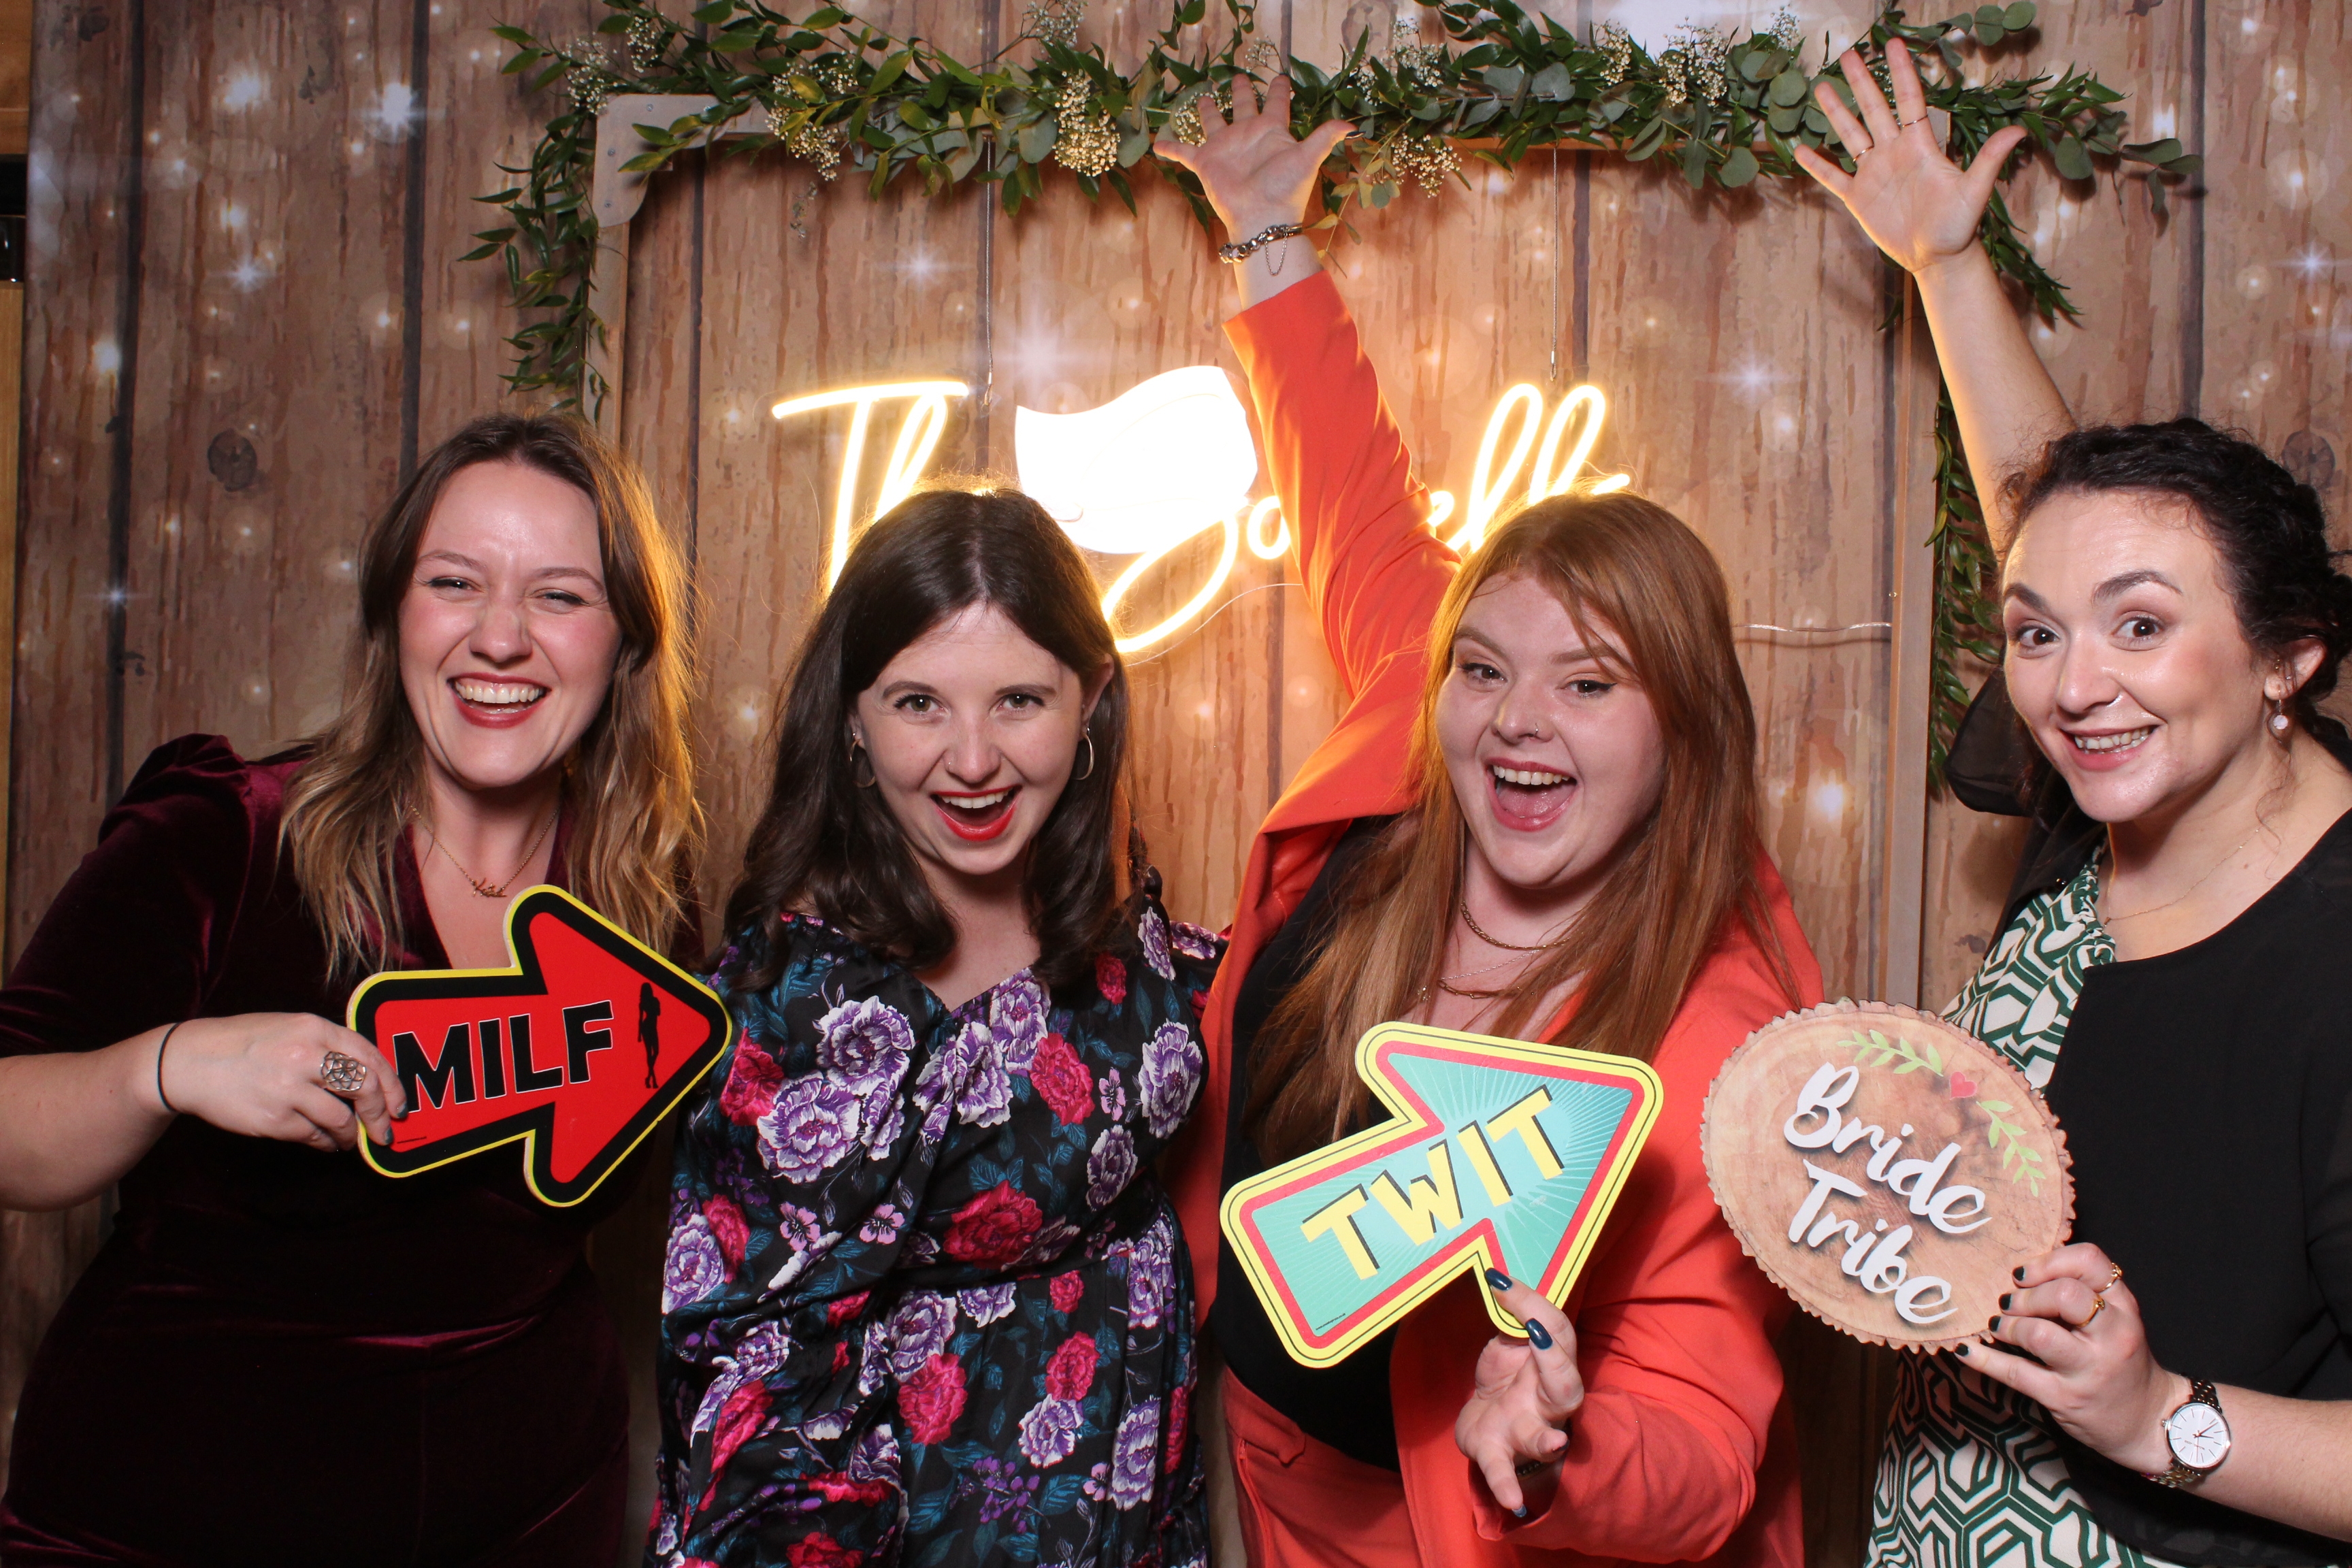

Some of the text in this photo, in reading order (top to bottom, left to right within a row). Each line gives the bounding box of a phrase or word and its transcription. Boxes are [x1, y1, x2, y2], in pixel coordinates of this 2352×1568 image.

[772, 380, 969, 593] Th
[392, 999, 615, 1113] MILF
[1300, 1083, 1565, 1280] TWIT
[1783, 1061, 1993, 1234] Bride
[1788, 1158, 1959, 1324] Tribe
